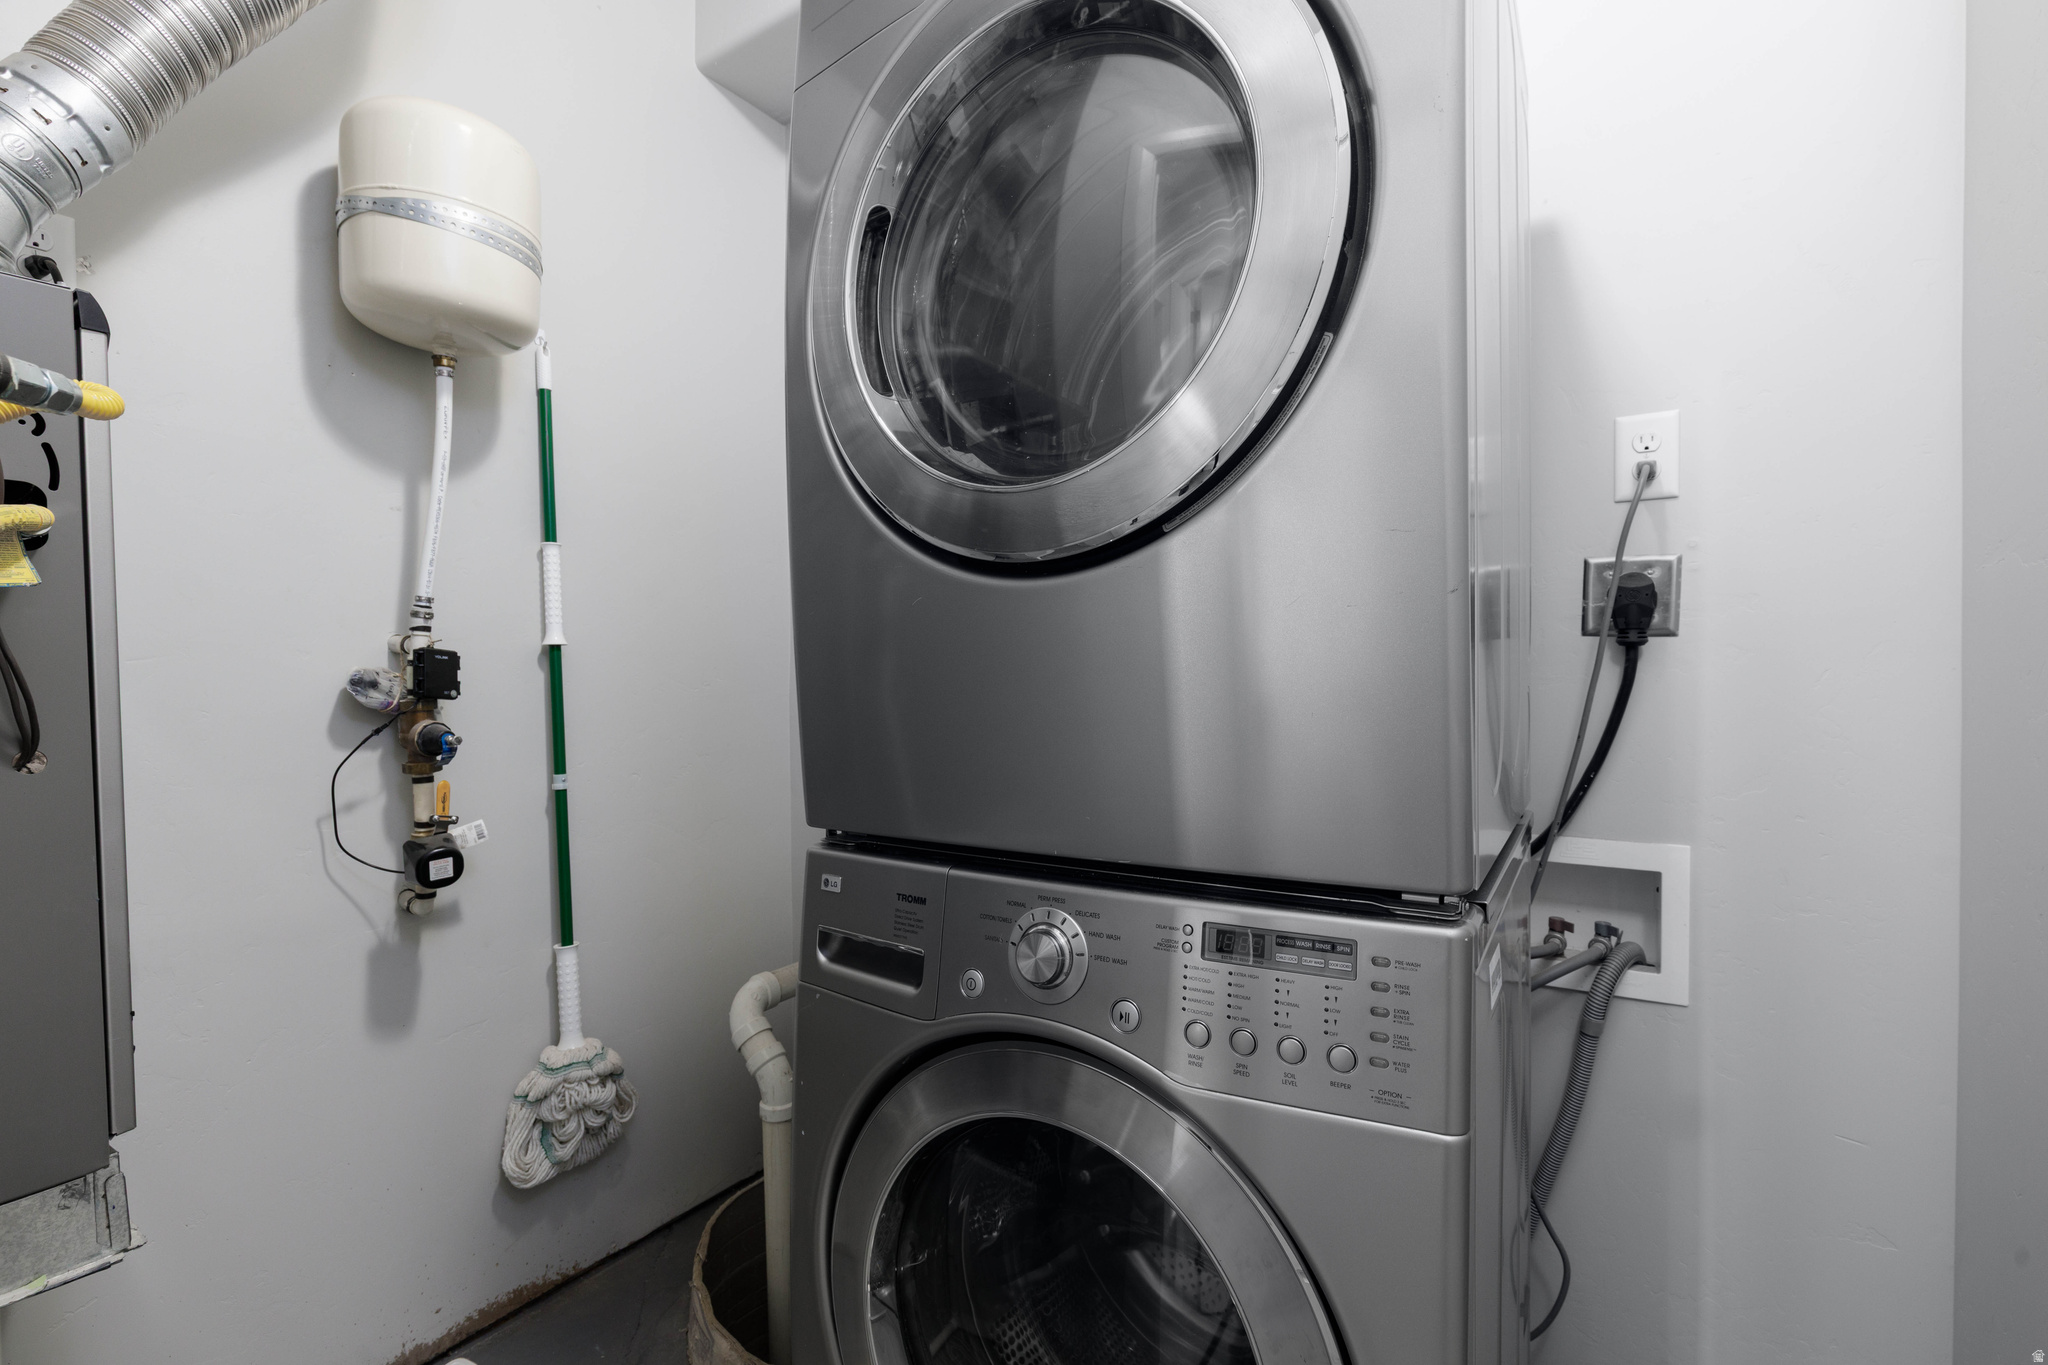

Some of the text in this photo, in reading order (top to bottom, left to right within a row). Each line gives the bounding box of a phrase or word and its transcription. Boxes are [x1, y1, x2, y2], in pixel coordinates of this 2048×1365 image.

[896, 893, 927, 906] TROMM
[1052, 896, 1066, 904] PRESS
[1007, 900, 1026, 908] NORMAL
[1075, 910, 1100, 919] DELICATES
[1106, 933, 1121, 941] WASH
[1277, 938, 1294, 946] PROCESS
[1094, 954, 1127, 966] SPEED WASH
[1188, 987, 1215, 995] WARM/WARM
[1188, 998, 1214, 1006] WARM/COLD
[1187, 1008, 1213, 1017] COLD/COLD
[1187, 1053, 1204, 1062] WASH/
[1188, 1060, 1203, 1068] RINSE
[1233, 1069, 1250, 1078] SPEED
[1282, 1079, 1297, 1087] LEVEL
[1330, 1081, 1352, 1090] BEEPER
[1378, 1090, 1402, 1099] OPTION
